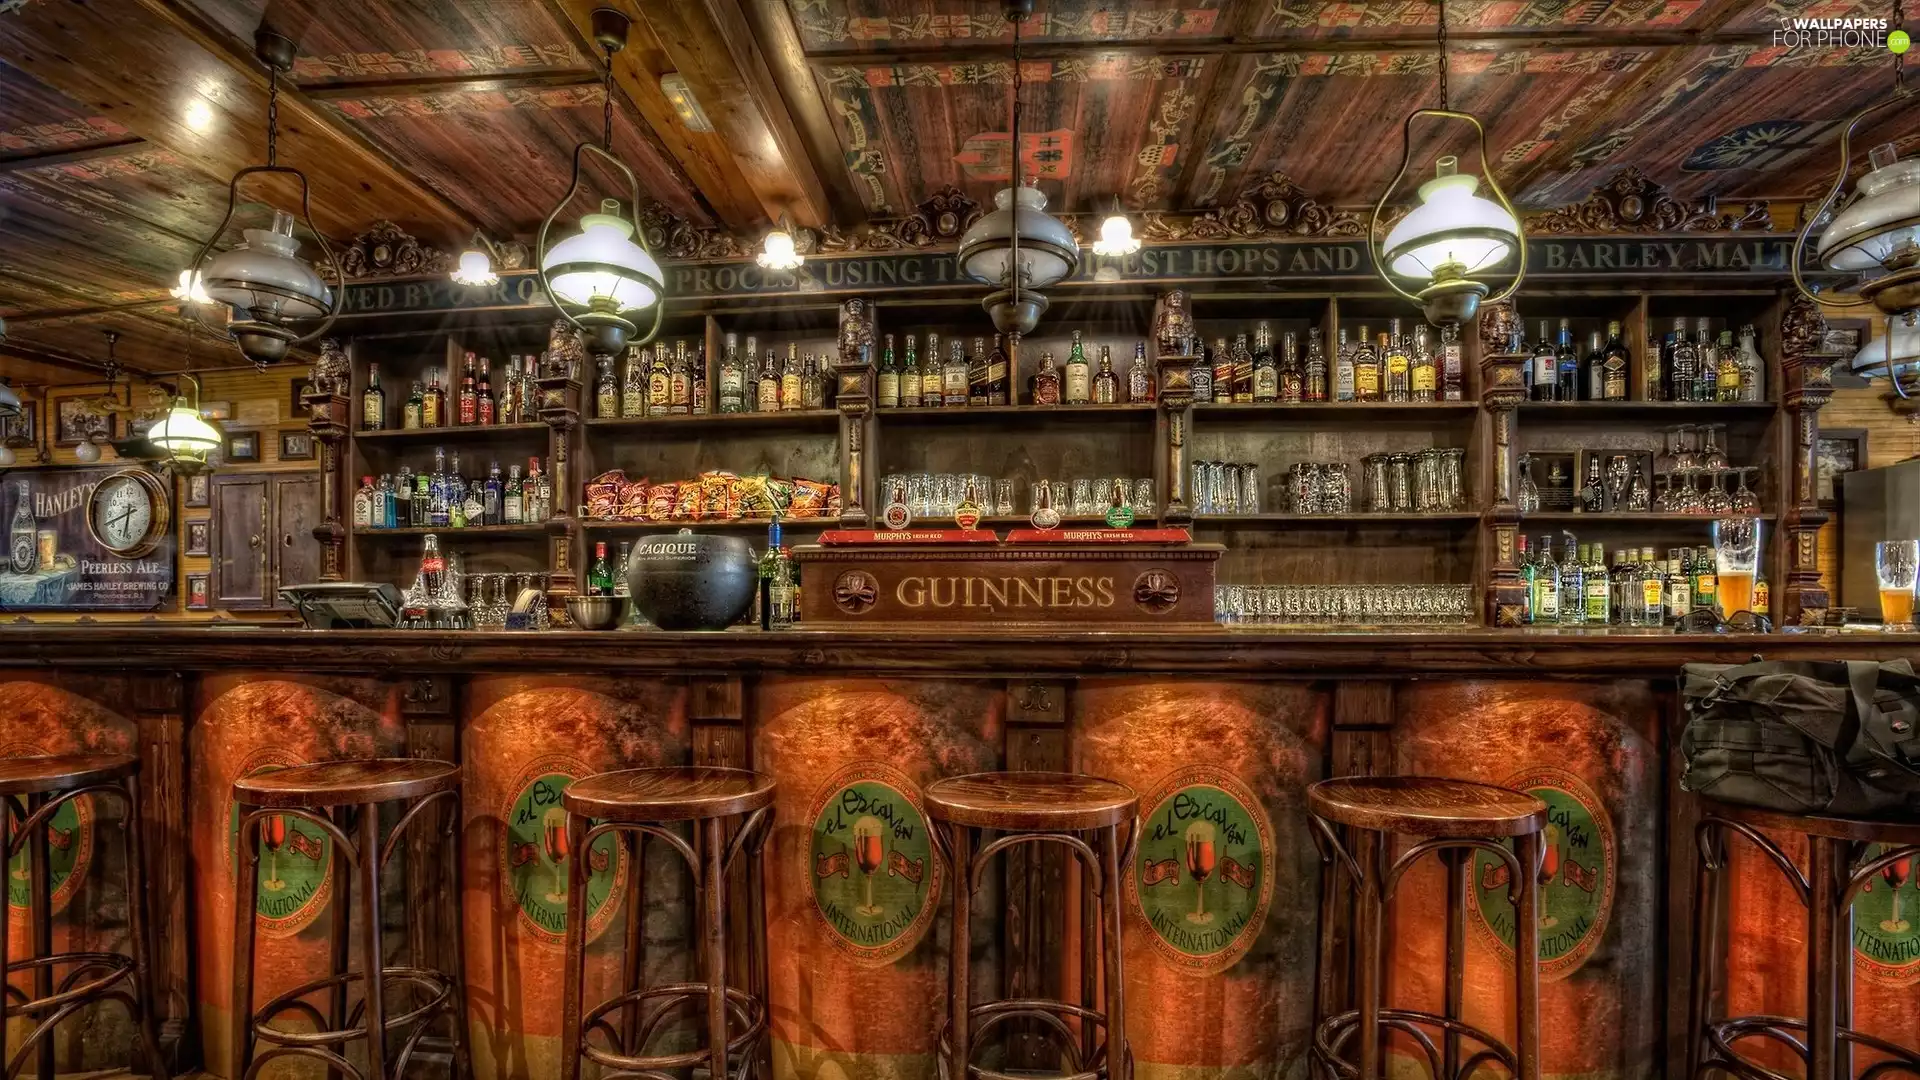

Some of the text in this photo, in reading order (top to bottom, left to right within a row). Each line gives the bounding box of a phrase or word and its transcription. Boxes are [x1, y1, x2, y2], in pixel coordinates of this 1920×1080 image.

[403, 282, 441, 308] BY
[675, 261, 817, 293] PROCESS
[825, 258, 925, 287] USING
[1191, 246, 1281, 275] HOPS
[1288, 245, 1360, 273] AND
[1545, 242, 1687, 270] BARLEY
[1696, 240, 1794, 270] MALT
[80, 558, 160, 575] PEERLESS ALE
[639, 542, 697, 556] CACIQUE
[94, 581, 121, 591] HANLEY
[123, 581, 157, 591] BREWING
[896, 576, 1115, 609] GUINNESS
[824, 900, 917, 943] INTERNATIONAL
[1151, 908, 1247, 951] INTERNATIONAL
[1491, 912, 1590, 957] INTATIONAL
